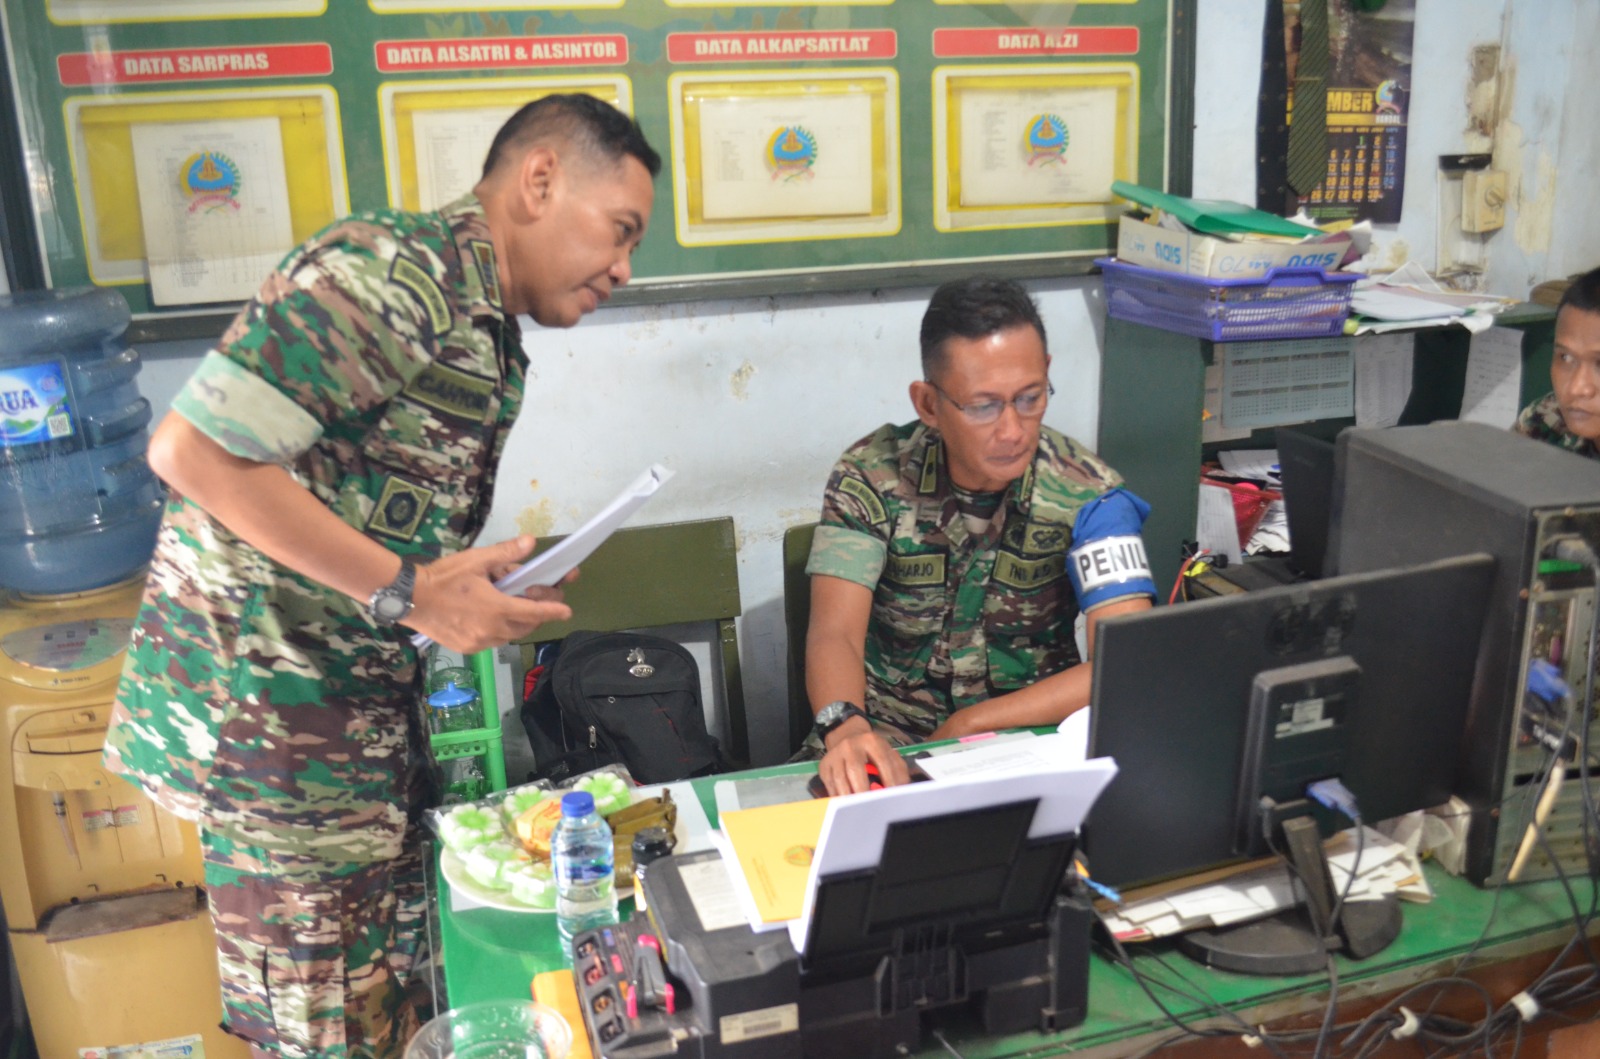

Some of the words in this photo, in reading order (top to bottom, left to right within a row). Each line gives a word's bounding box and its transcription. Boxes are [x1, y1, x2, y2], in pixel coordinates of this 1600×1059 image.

[695, 39, 743, 55] DATA
[747, 36, 870, 54] ALKAPSATLAT
[998, 34, 1040, 49] DATA
[124, 57, 175, 75] DATA
[177, 52, 269, 73] SARPRAS
[387, 47, 434, 64] DATA
[437, 44, 510, 63] ALSATRI
[515, 45, 528, 60] &
[531, 42, 617, 60] ALSINTOR
[0, 389, 39, 416] UA
[1078, 543, 1149, 582] PENIL
